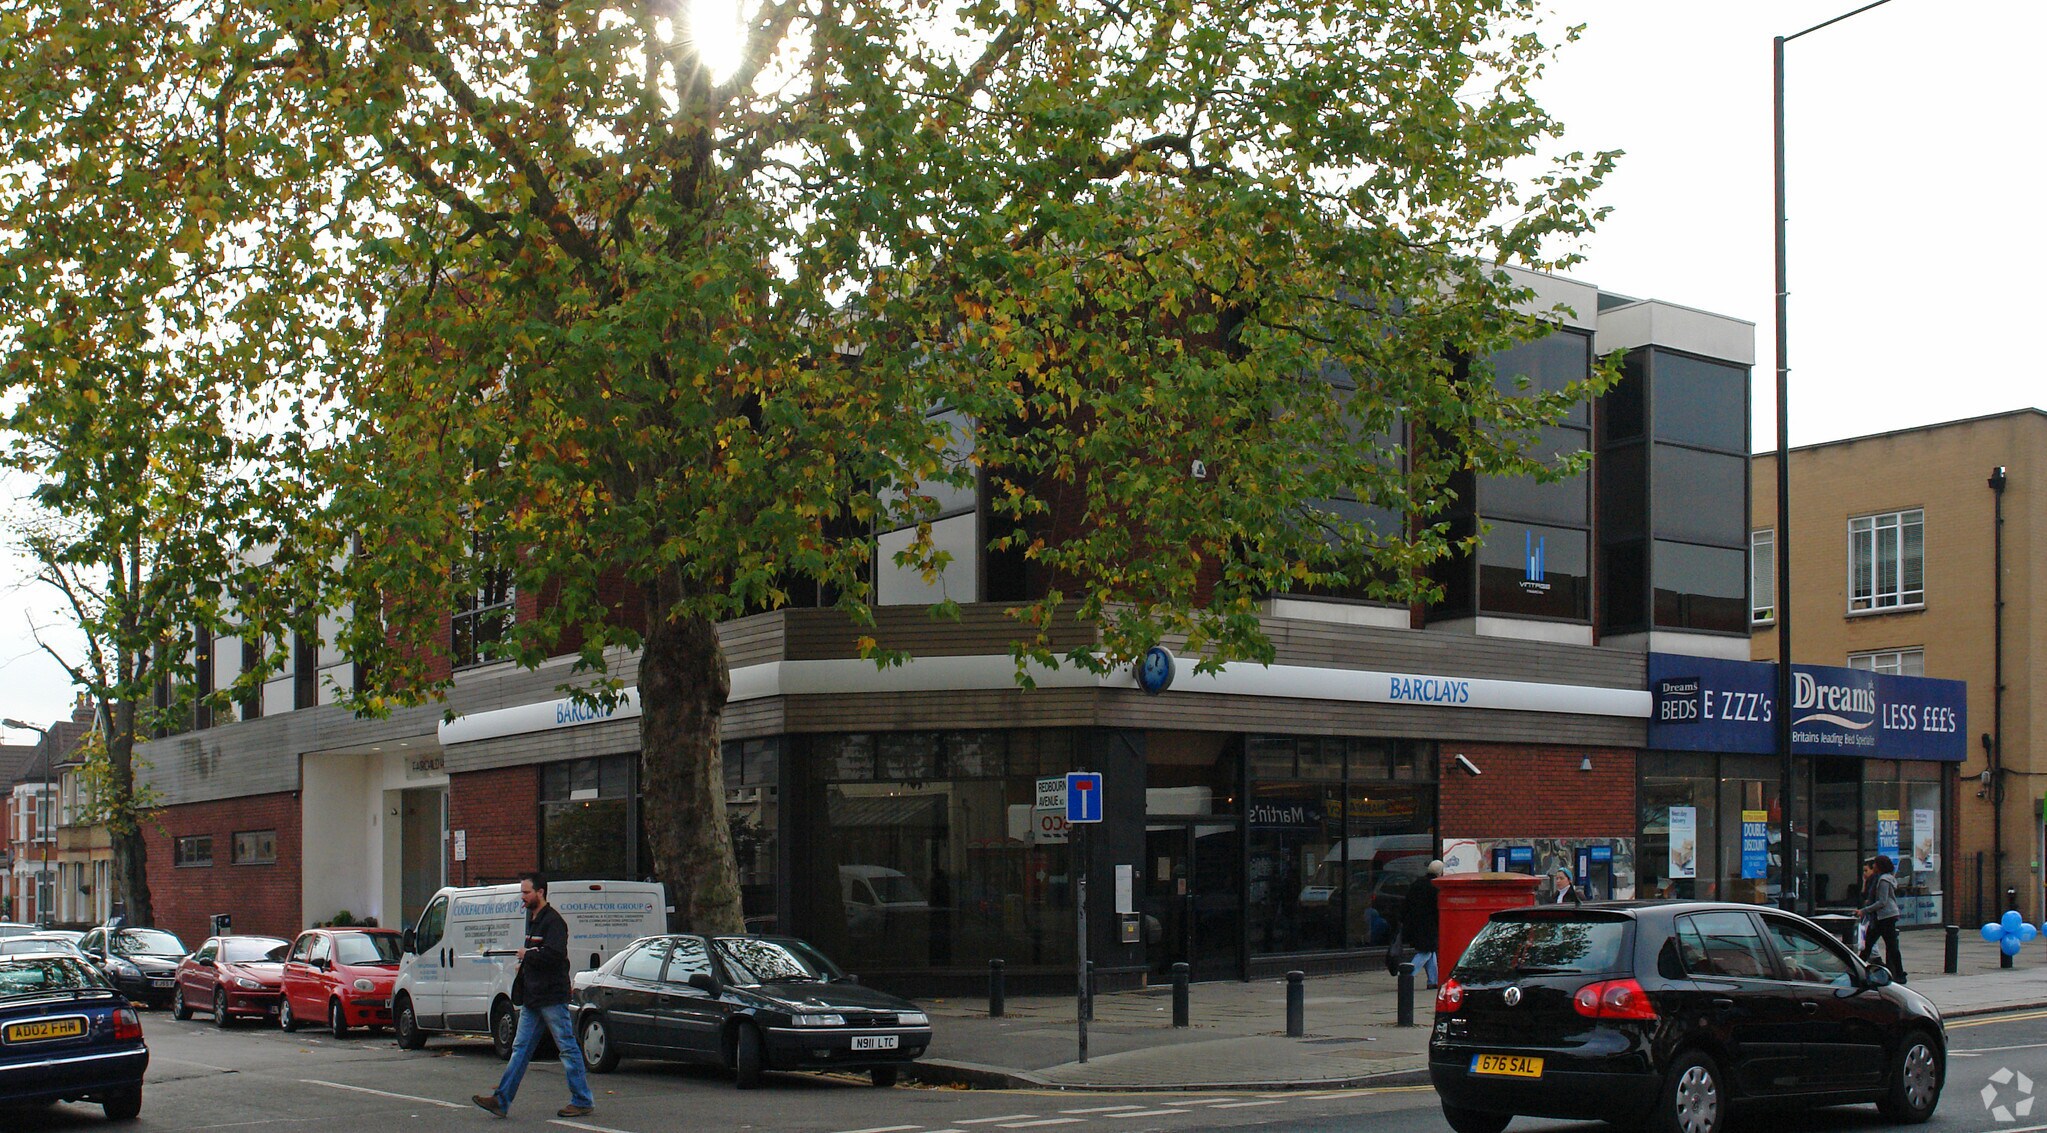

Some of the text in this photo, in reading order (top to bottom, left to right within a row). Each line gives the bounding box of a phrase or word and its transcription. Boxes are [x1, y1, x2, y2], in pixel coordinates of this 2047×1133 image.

[1390, 677, 1469, 703] BARCLAYS
[1662, 699, 1698, 720] BEDS
[1704, 690, 1772, 722] E ZZZ's
[1882, 704, 1916, 730] LESS
[1792, 731, 1820, 742] Britains
[1821, 732, 1843, 747] leading
[1844, 734, 1855, 745] Bed
[1039, 796, 1058, 806] AVENUE
[1744, 824, 1766, 836] DOUBLE
[1880, 821, 1898, 835] SAVE
[1744, 839, 1765, 851] DISCOUNT
[1880, 836, 1898, 847] TWICE
[454, 901, 519, 916] COOLFACTOR GROUP
[16, 1024, 48, 1037] AD02
[857, 1038, 893, 1048] N911 LTC
[1483, 1056, 1534, 1073] 676 SAL
